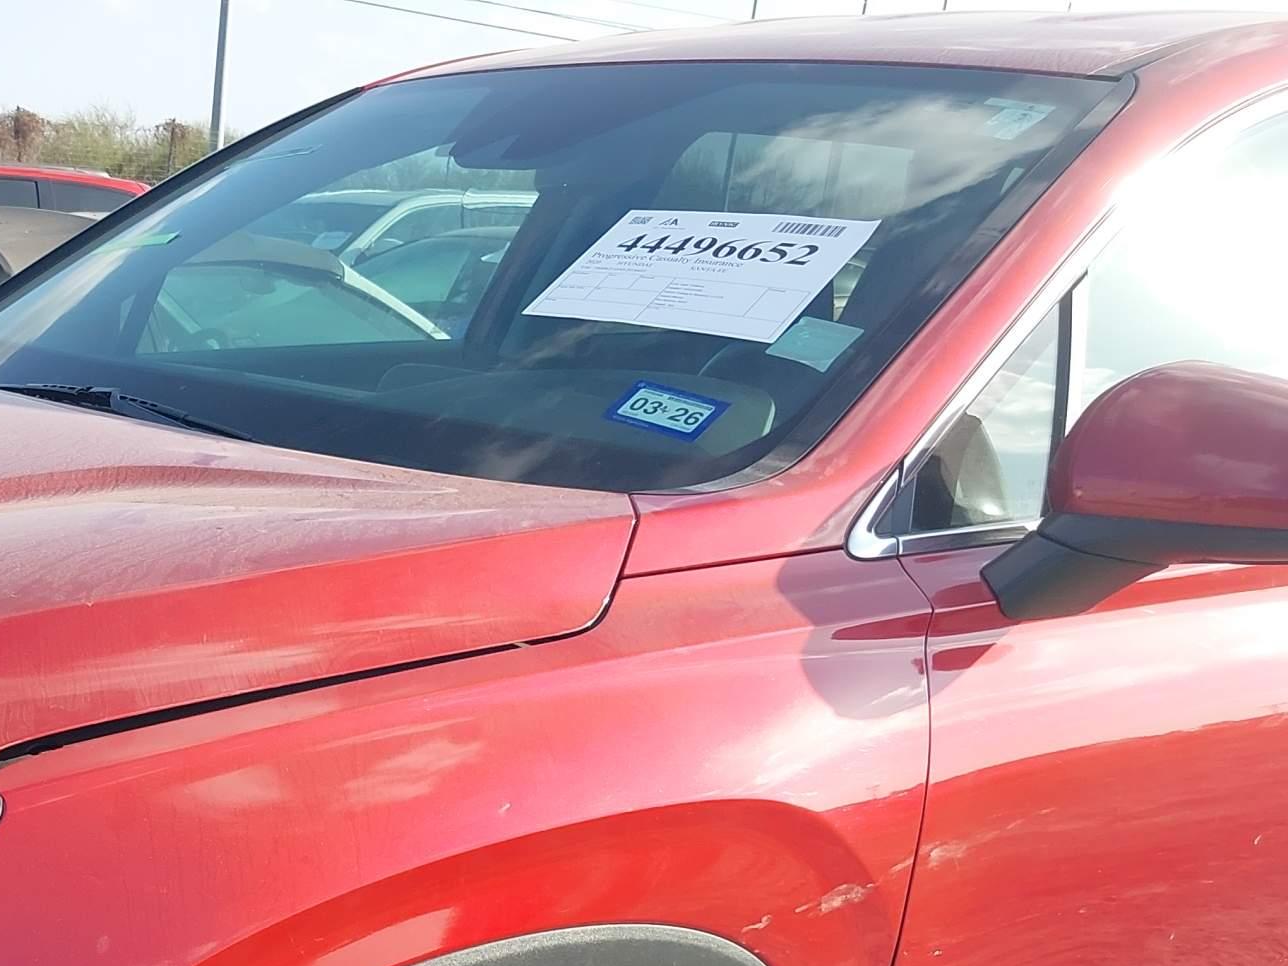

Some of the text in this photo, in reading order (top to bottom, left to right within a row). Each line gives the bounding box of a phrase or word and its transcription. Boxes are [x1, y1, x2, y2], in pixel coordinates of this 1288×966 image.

[592, 252, 744, 268] Progressive Casualty Insurance
[617, 233, 820, 266] 44496652
[630, 397, 664, 415] 03
[667, 407, 705, 426] 26
